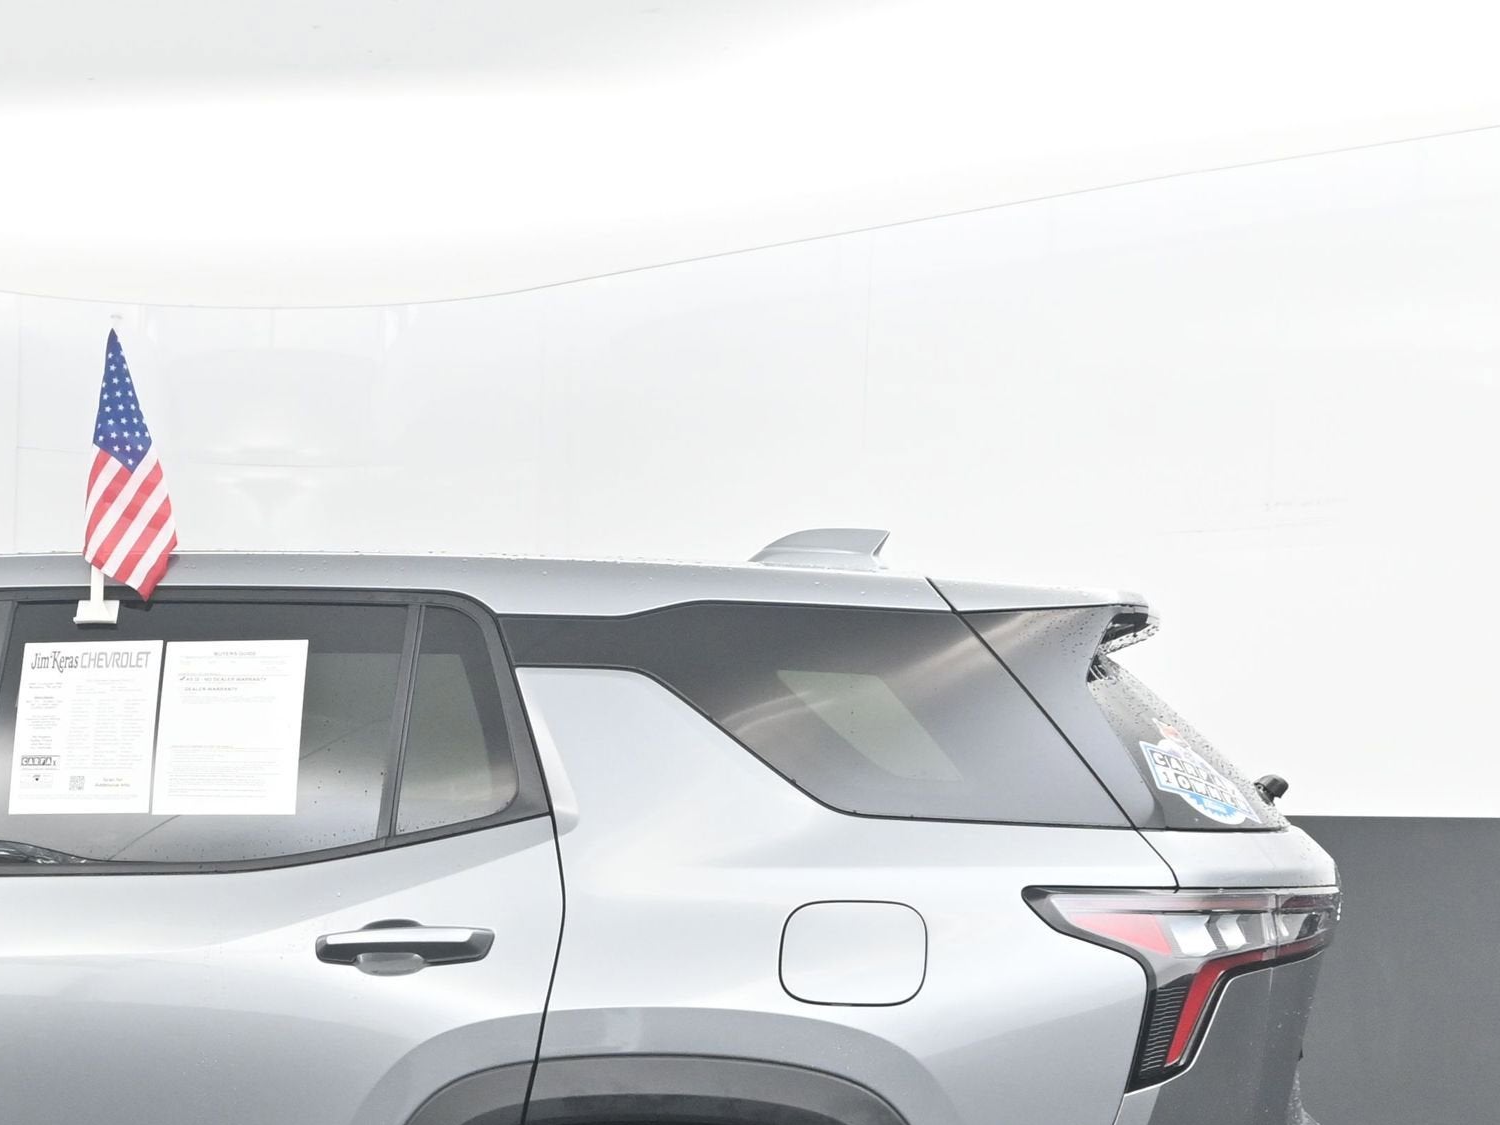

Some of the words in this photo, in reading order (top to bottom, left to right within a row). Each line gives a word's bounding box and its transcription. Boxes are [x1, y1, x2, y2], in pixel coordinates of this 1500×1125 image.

[30, 652, 50, 670] Jim
[51, 650, 80, 674] Keras
[80, 651, 152, 669] CHEVROLET
